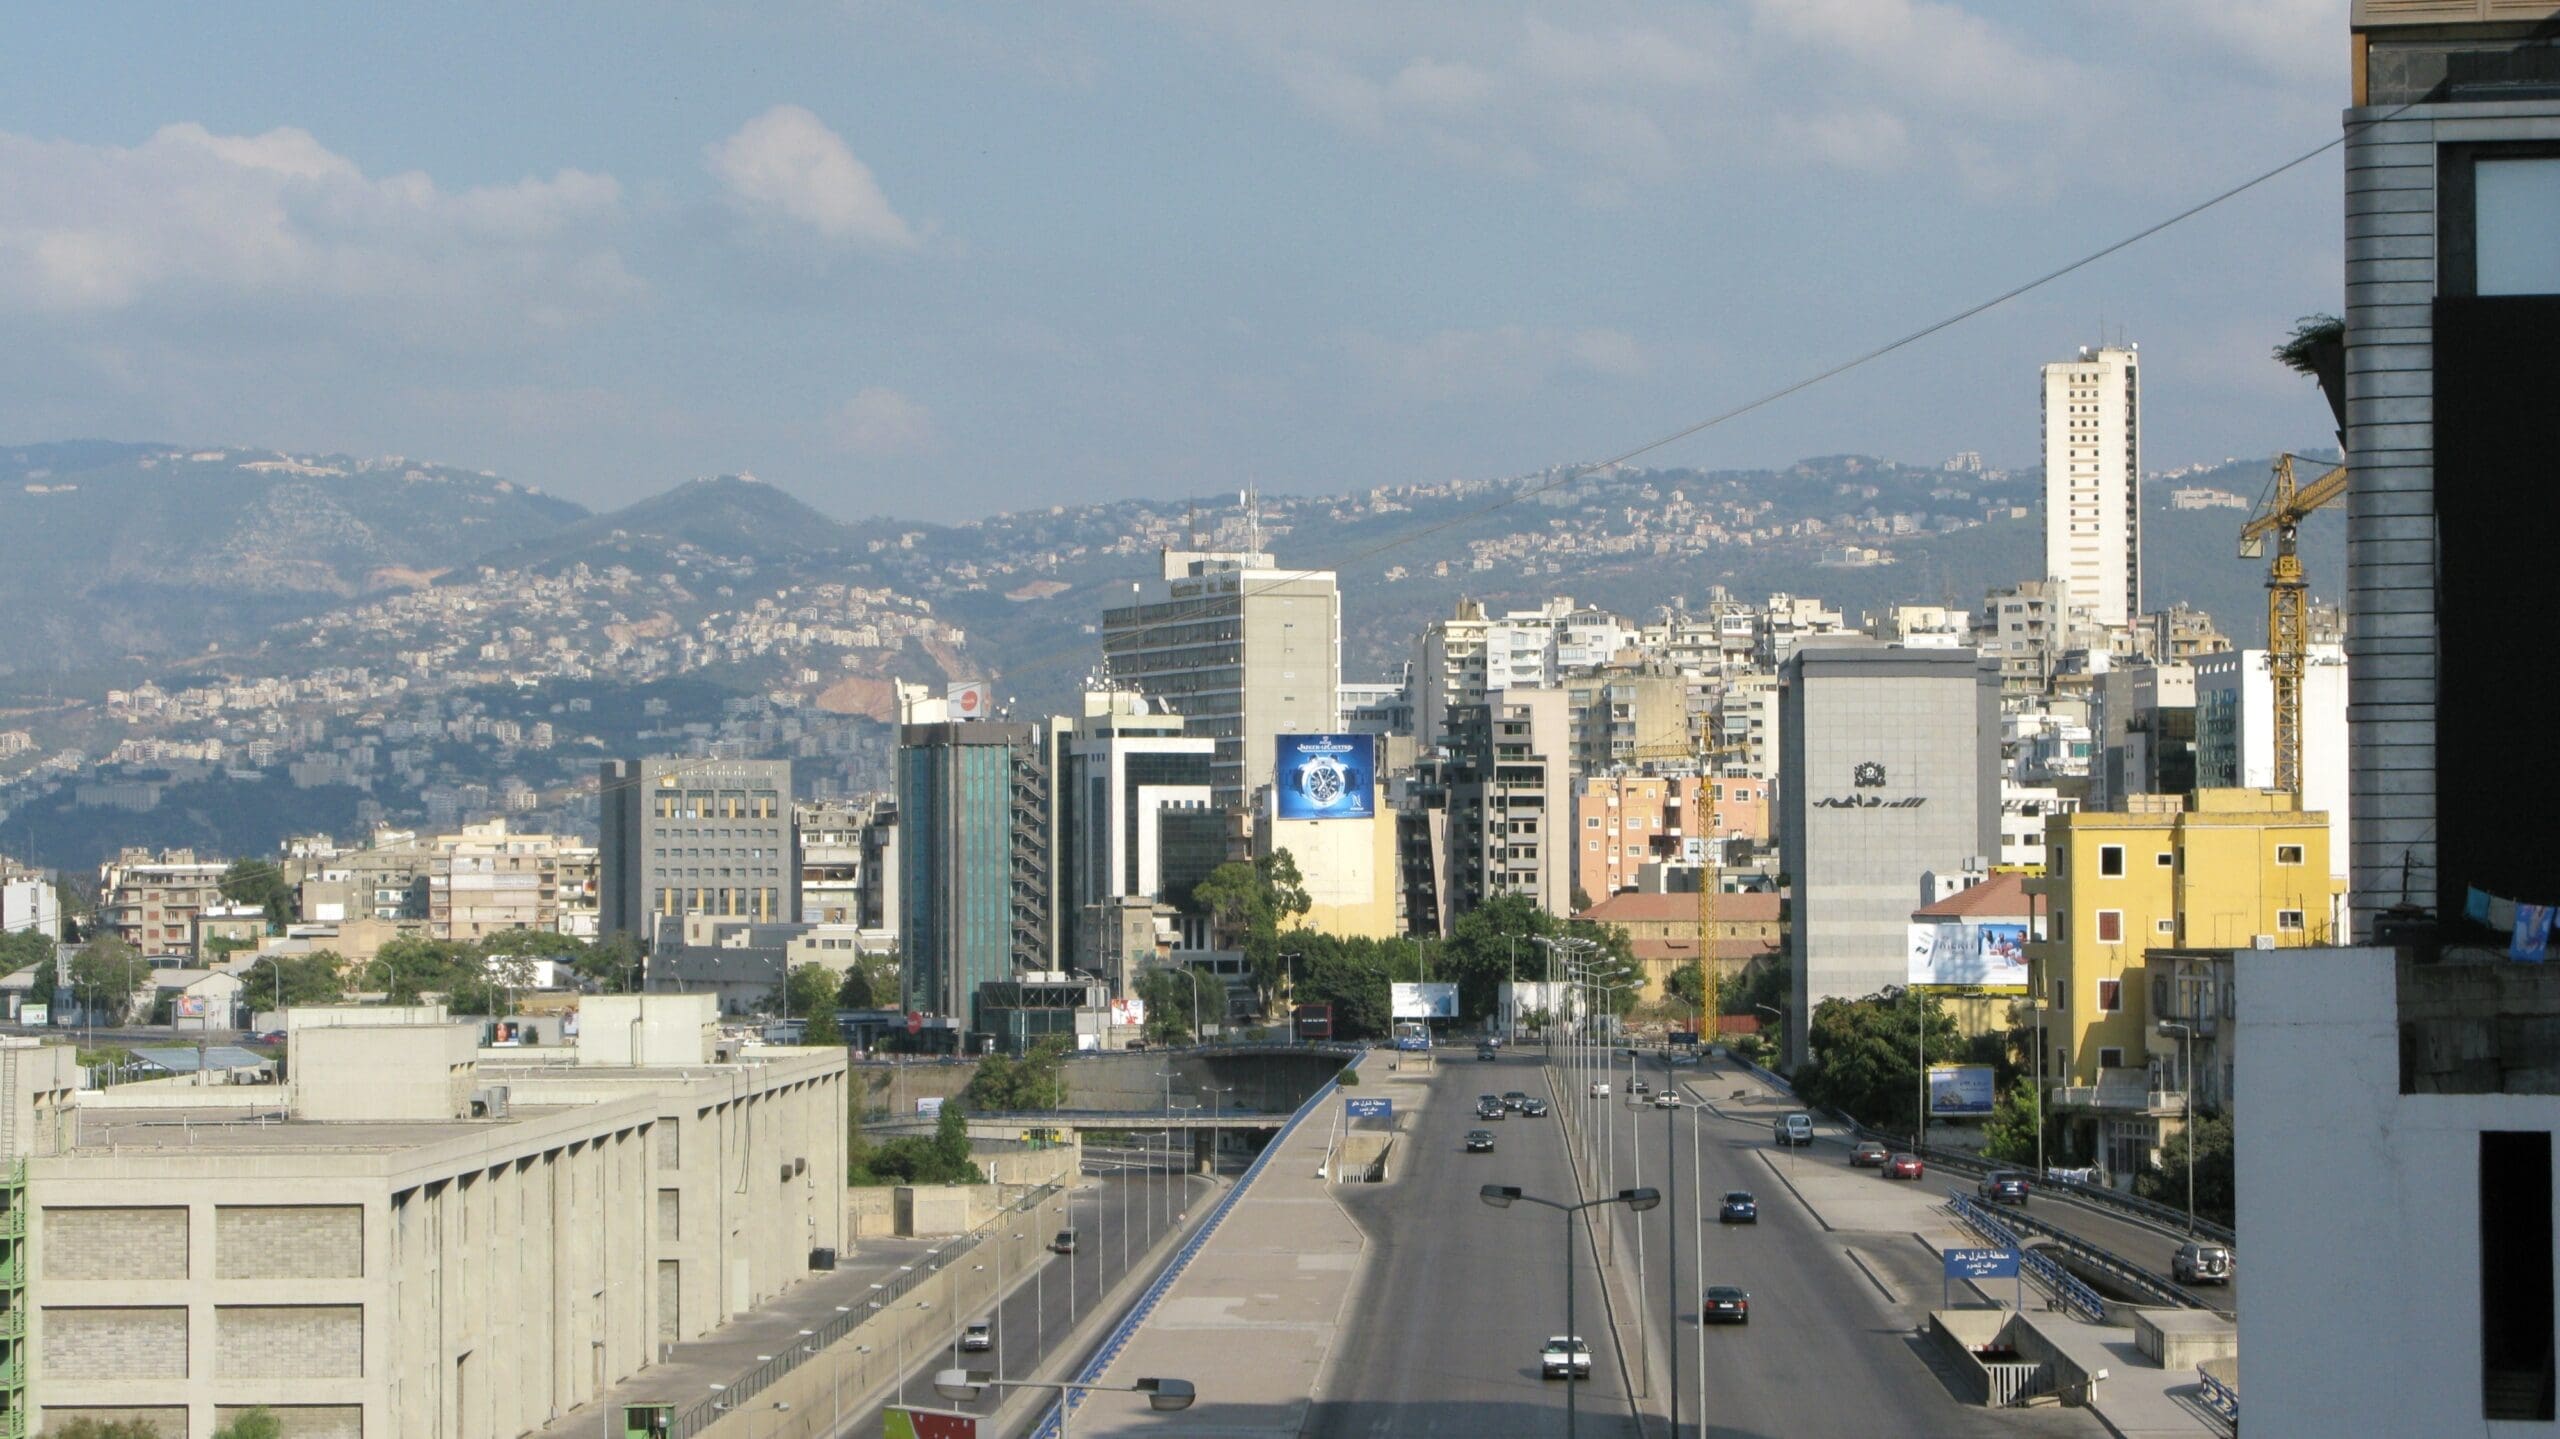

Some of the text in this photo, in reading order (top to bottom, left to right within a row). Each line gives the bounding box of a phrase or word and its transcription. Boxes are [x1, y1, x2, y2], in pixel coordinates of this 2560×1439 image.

[1953, 1250, 2010, 1261] محطة شارل حلو
